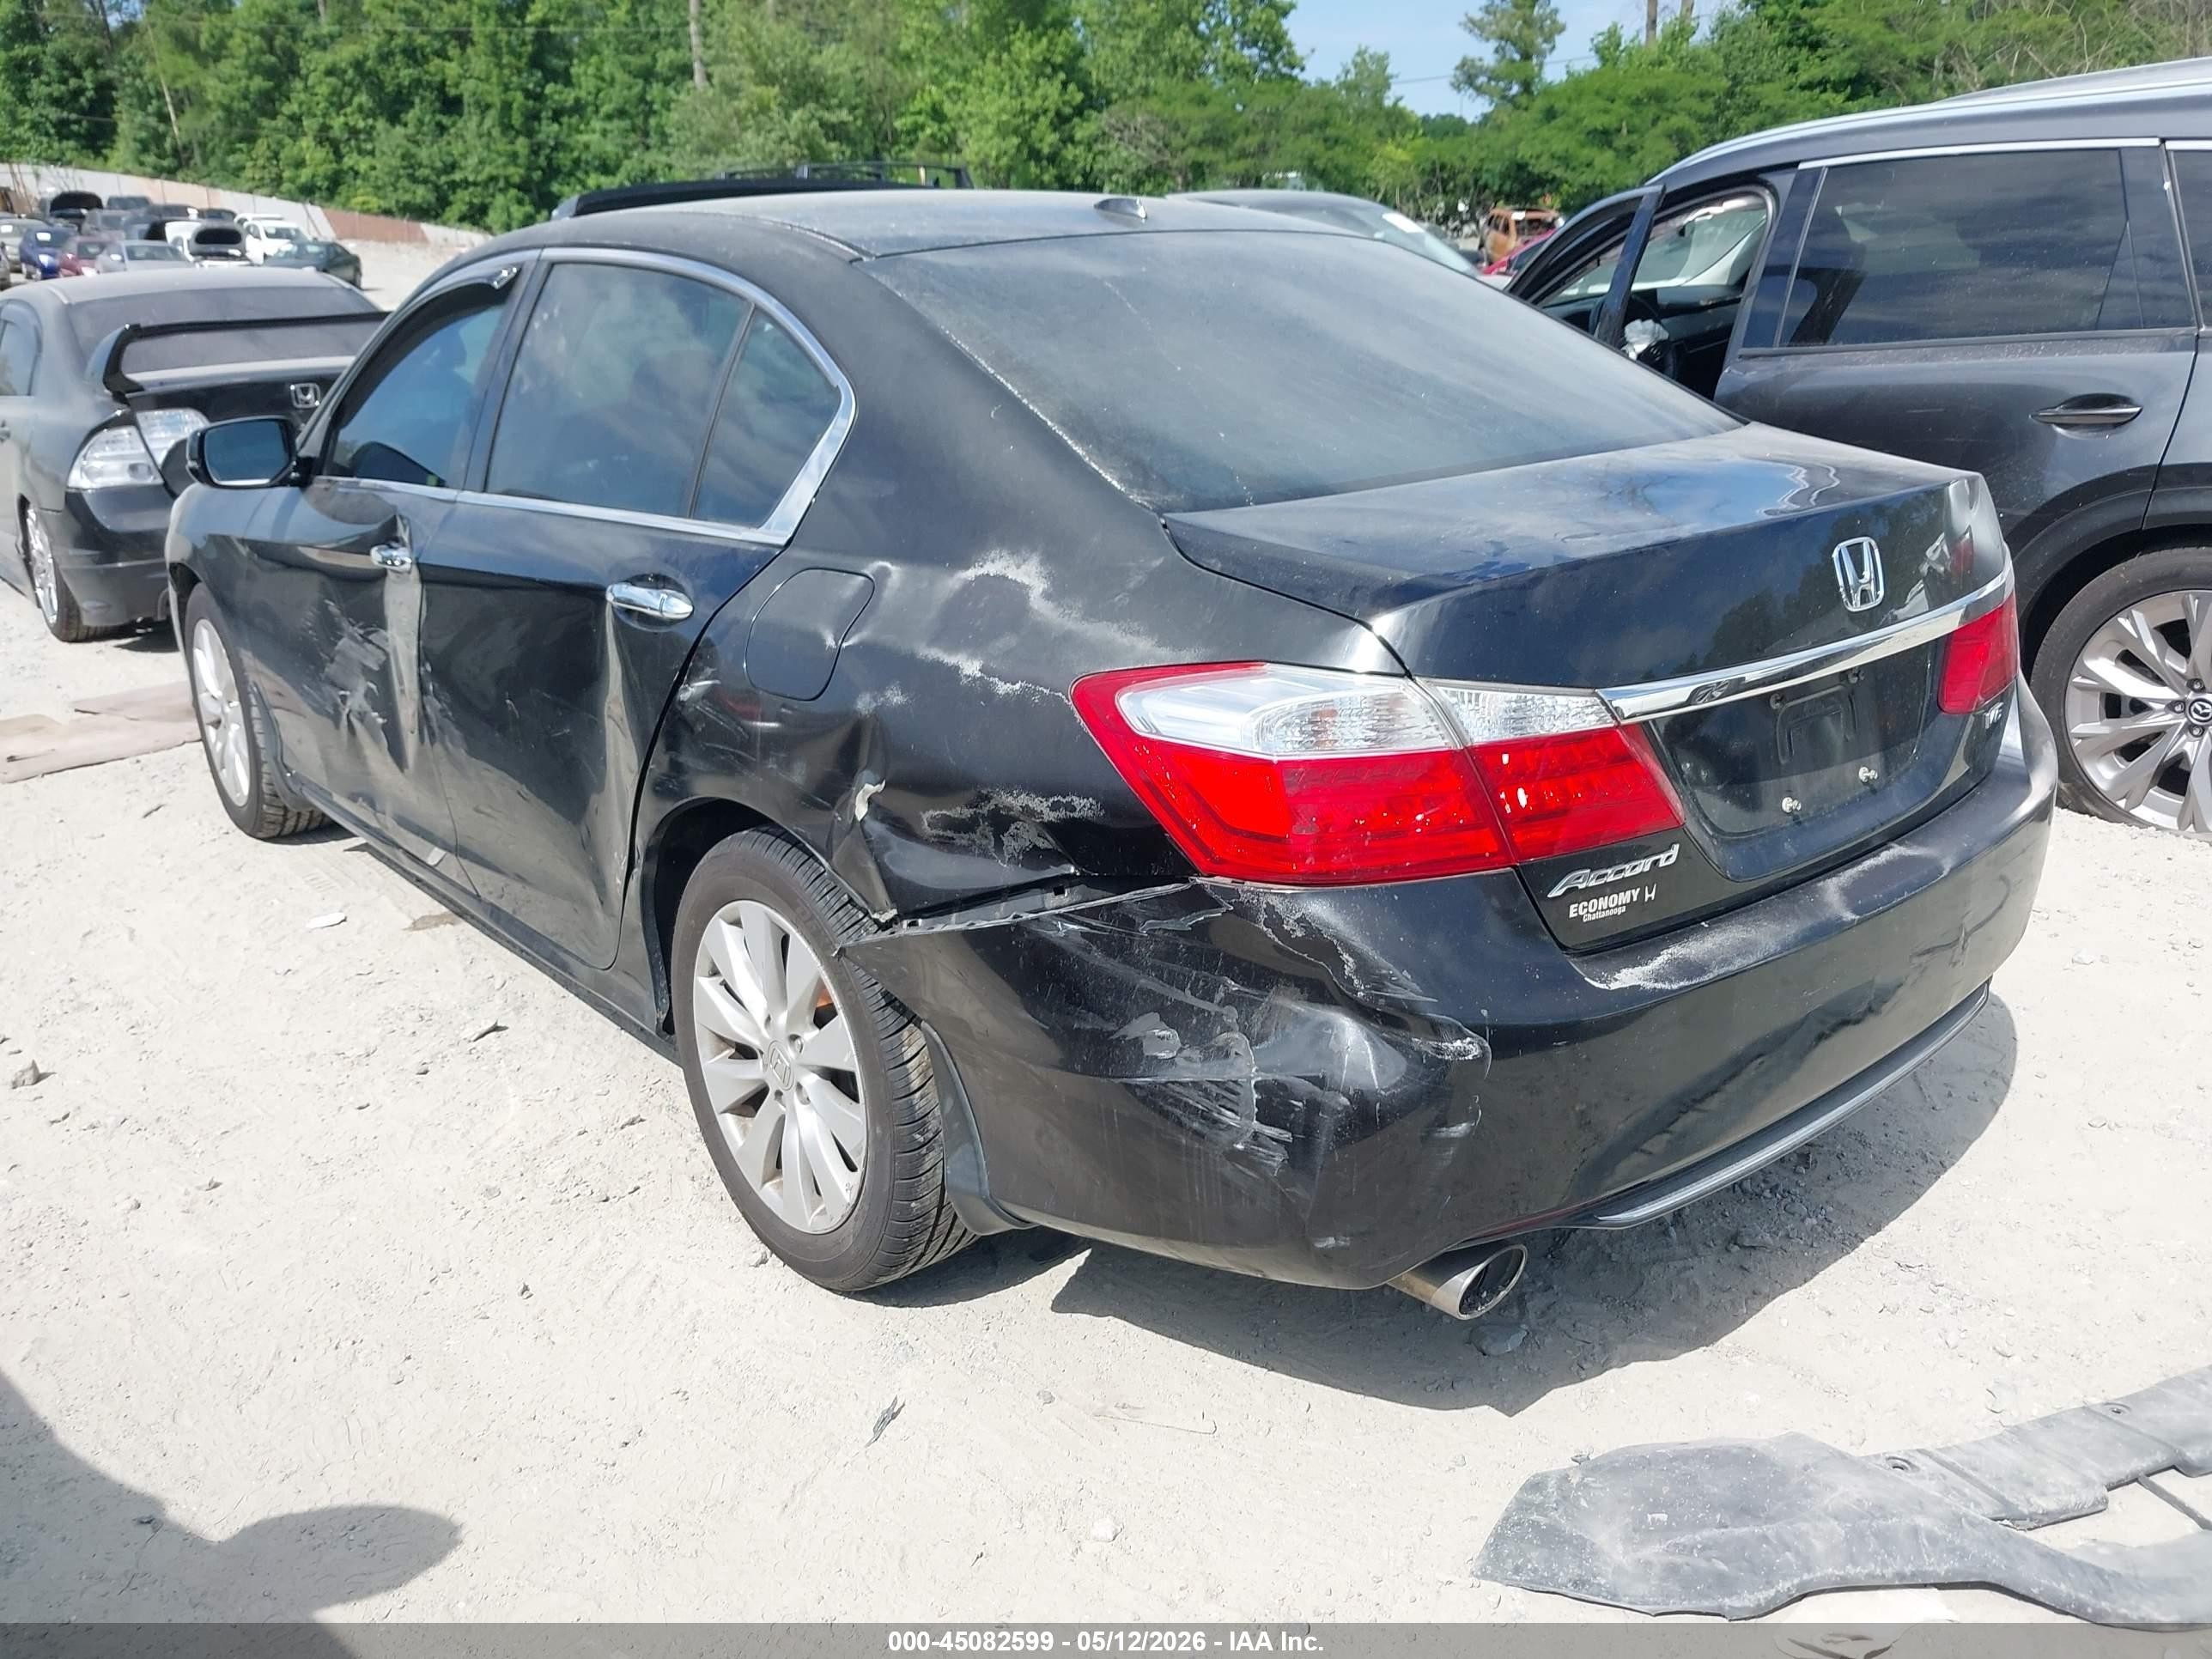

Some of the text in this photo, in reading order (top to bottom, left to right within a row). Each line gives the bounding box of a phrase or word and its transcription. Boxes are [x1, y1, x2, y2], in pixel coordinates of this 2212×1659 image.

[1547, 843, 1680, 898] Accord
[1569, 888, 1641, 918] ECONOMY
[1583, 905, 1626, 923] Chattanooga
